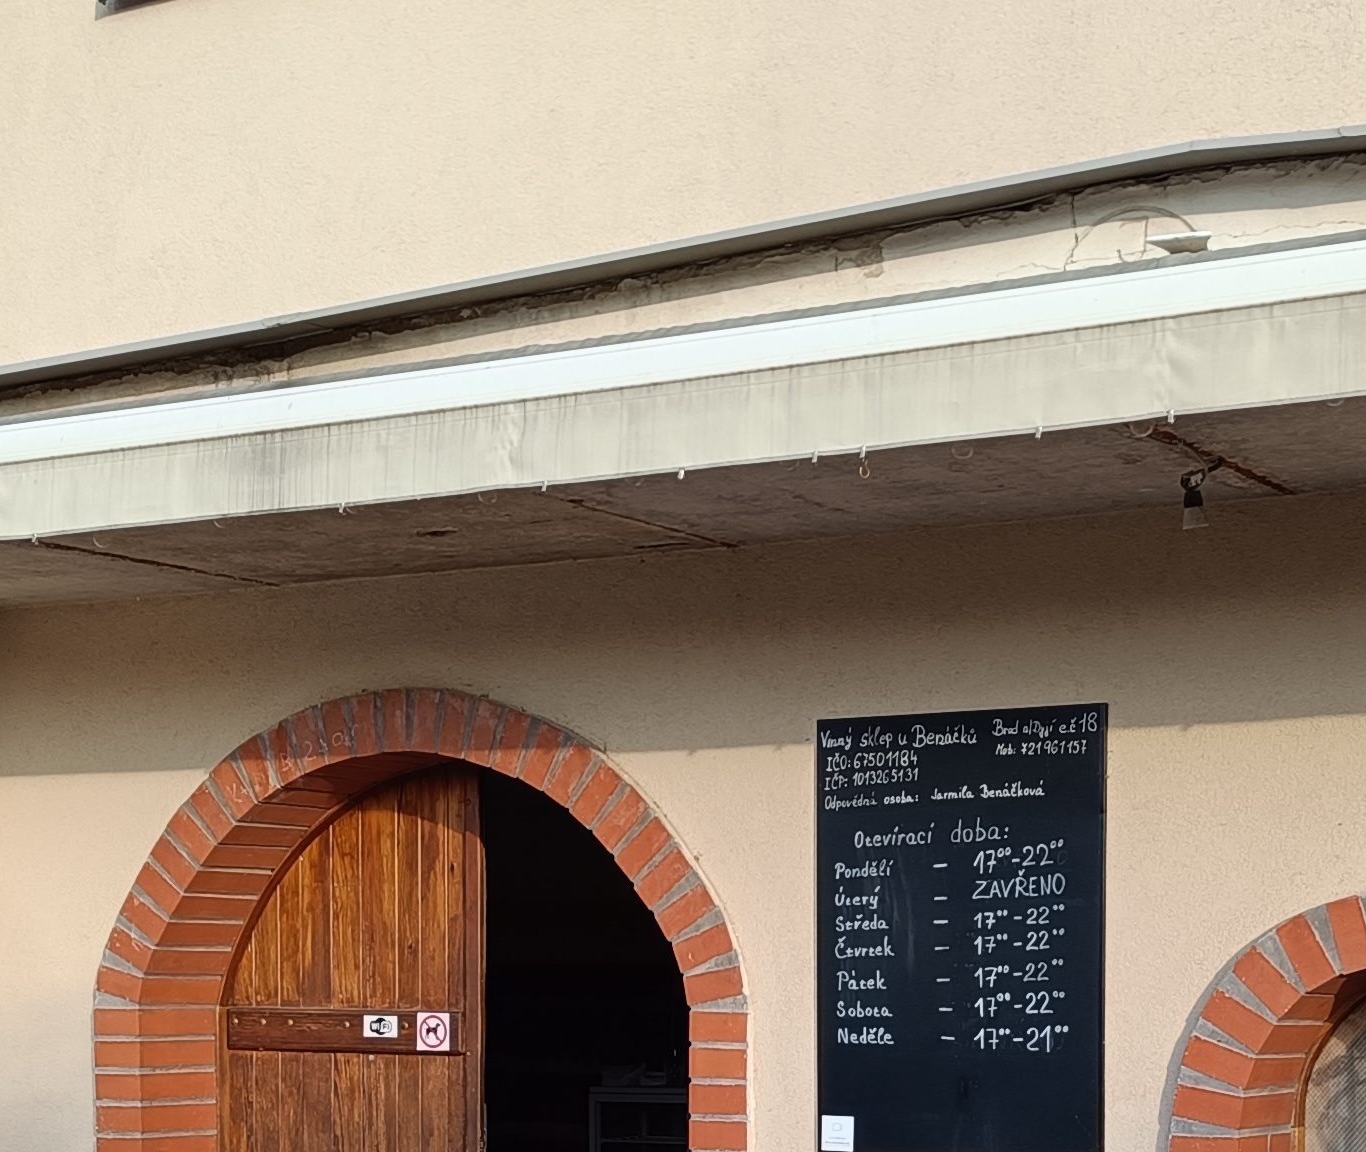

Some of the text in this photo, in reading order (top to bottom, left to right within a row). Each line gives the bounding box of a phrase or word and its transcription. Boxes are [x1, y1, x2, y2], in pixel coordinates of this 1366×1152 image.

[992, 719, 1019, 736] Brod
[1079, 712, 1097, 732] 18
[821, 724, 977, 750] Vinný sklep u Benáčků
[826, 750, 918, 771] IČO: 67501184
[852, 768, 919, 786] 1013265131
[825, 780, 1045, 811] Odpovědná osoba: Jarmila Benáčková
[855, 817, 1009, 848] Otevírací doba:
[835, 860, 894, 880] Pondělí
[835, 886, 881, 908] Úterý
[972, 869, 1066, 900] ZAVŘENO
[835, 914, 889, 932] Středa
[835, 936, 895, 959] Čtvrtek
[836, 970, 887, 990] Pátek
[836, 1001, 893, 1018] Sobota
[837, 1027, 894, 1045] Neděle
